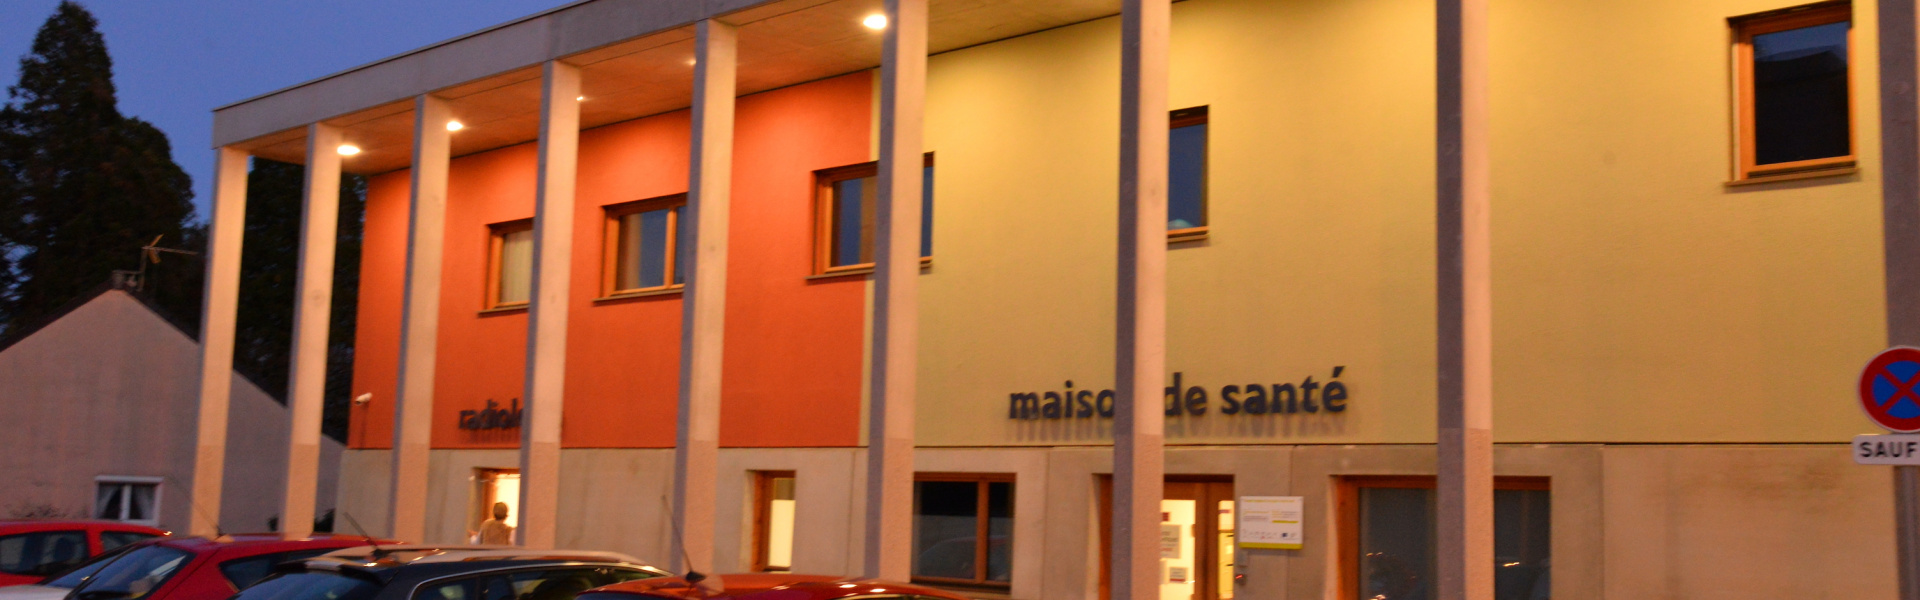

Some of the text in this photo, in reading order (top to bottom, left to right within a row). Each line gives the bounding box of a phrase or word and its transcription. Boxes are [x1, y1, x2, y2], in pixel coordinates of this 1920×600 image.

[1008, 366, 1348, 420] maiso de santé
[1859, 441, 1918, 458] SAUF
